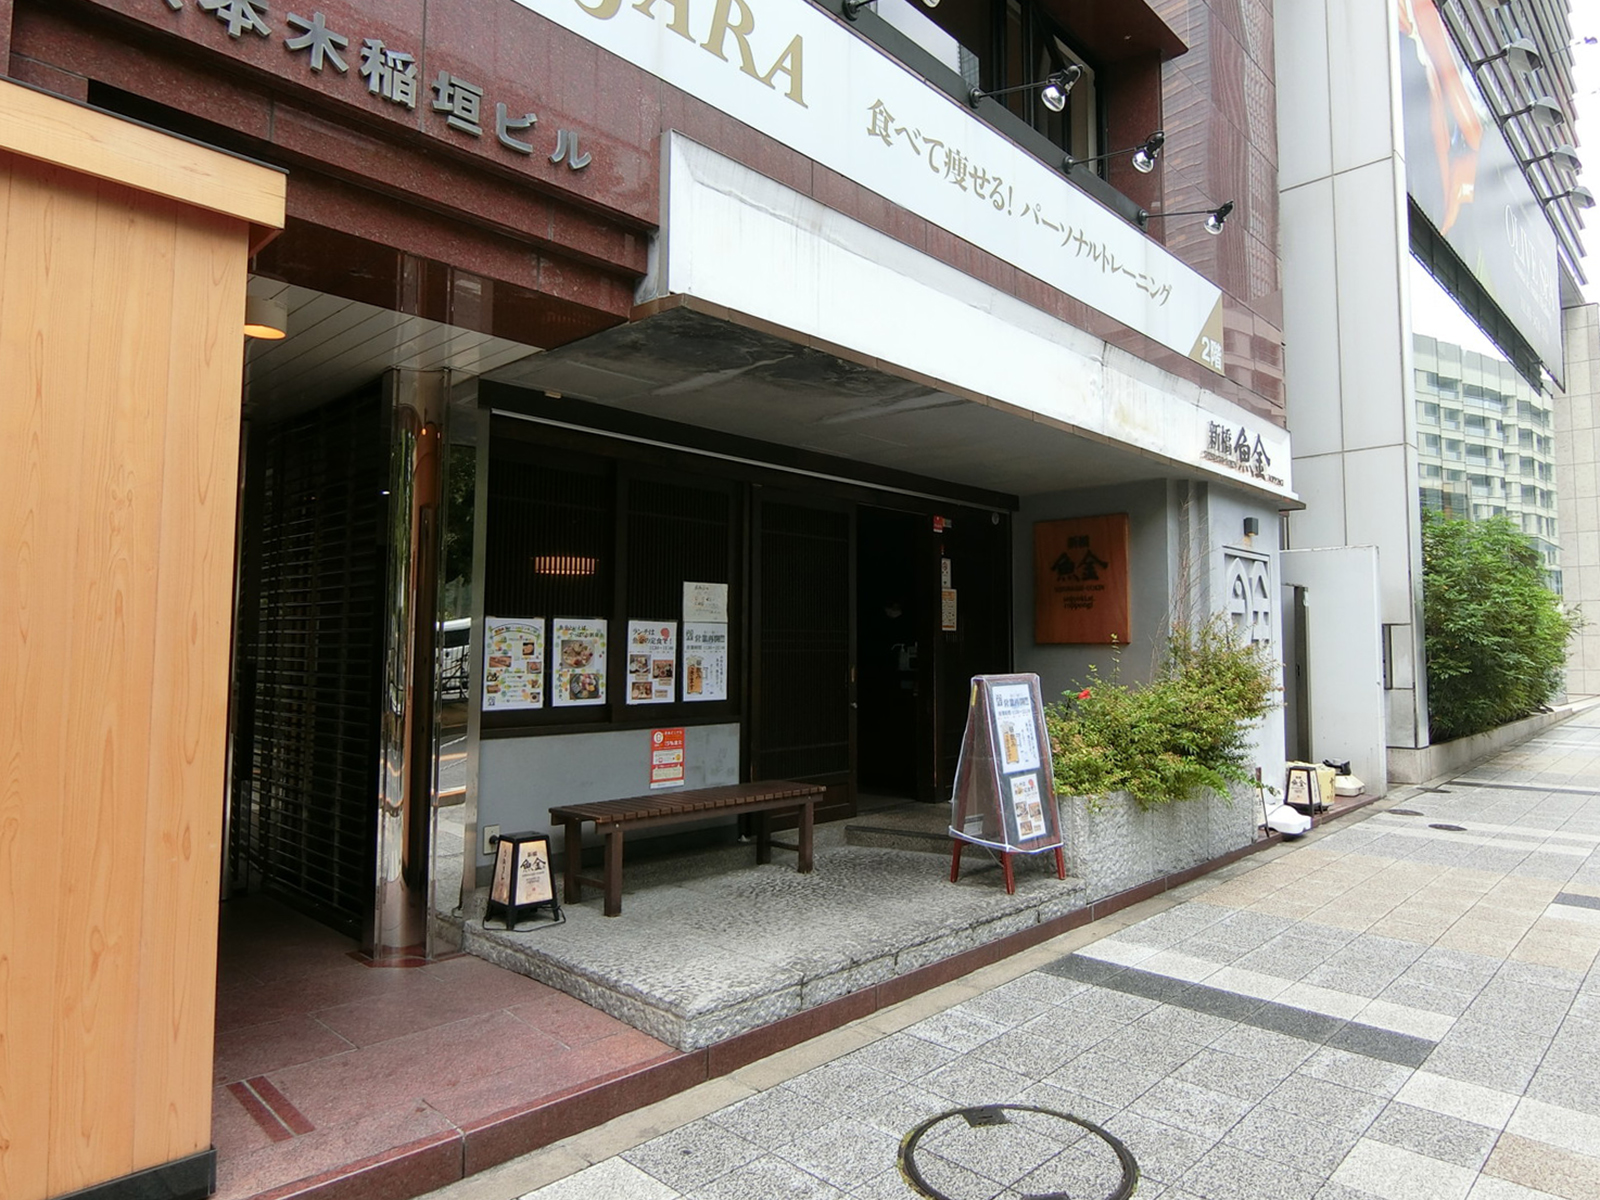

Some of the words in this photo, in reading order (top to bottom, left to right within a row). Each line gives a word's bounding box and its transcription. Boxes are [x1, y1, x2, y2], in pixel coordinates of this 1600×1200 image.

[165, 0, 592, 170] 本木稲垣ビル
[1020, 203, 1173, 306] パーソナルトレーニング
[1201, 336, 1222, 371] 2階
[1051, 550, 1109, 582] 魚金
[520, 857, 546, 873] 魚金
